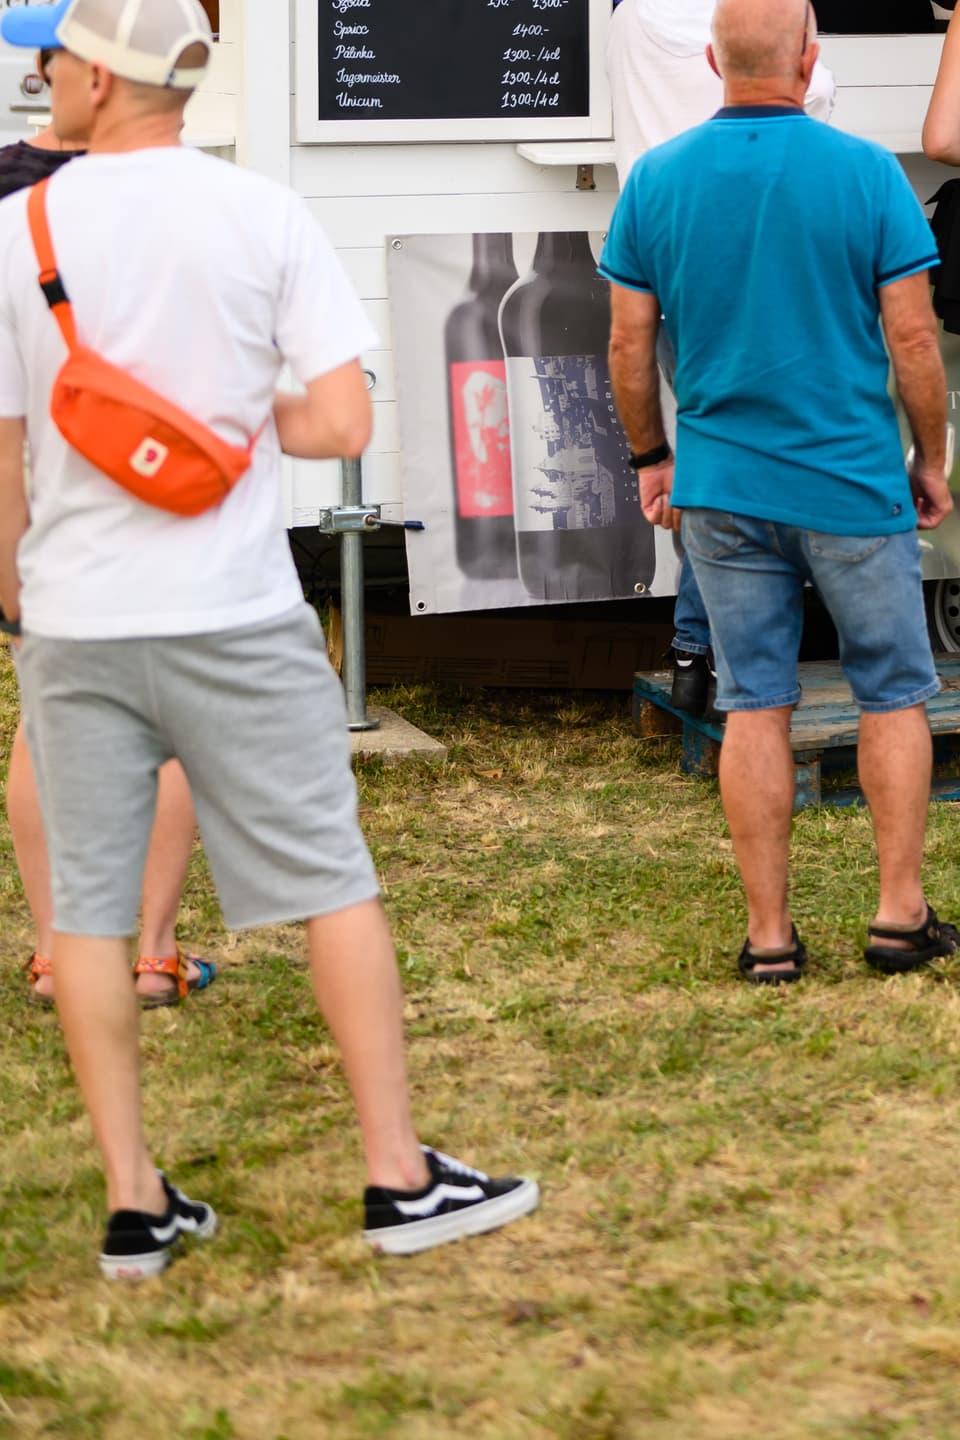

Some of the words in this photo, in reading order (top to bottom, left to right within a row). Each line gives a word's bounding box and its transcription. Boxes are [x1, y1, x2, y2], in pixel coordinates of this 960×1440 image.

[333, 20, 369, 39] Spricc
[333, 45, 376, 59] Pálinka
[336, 92, 383, 108] Unicum
